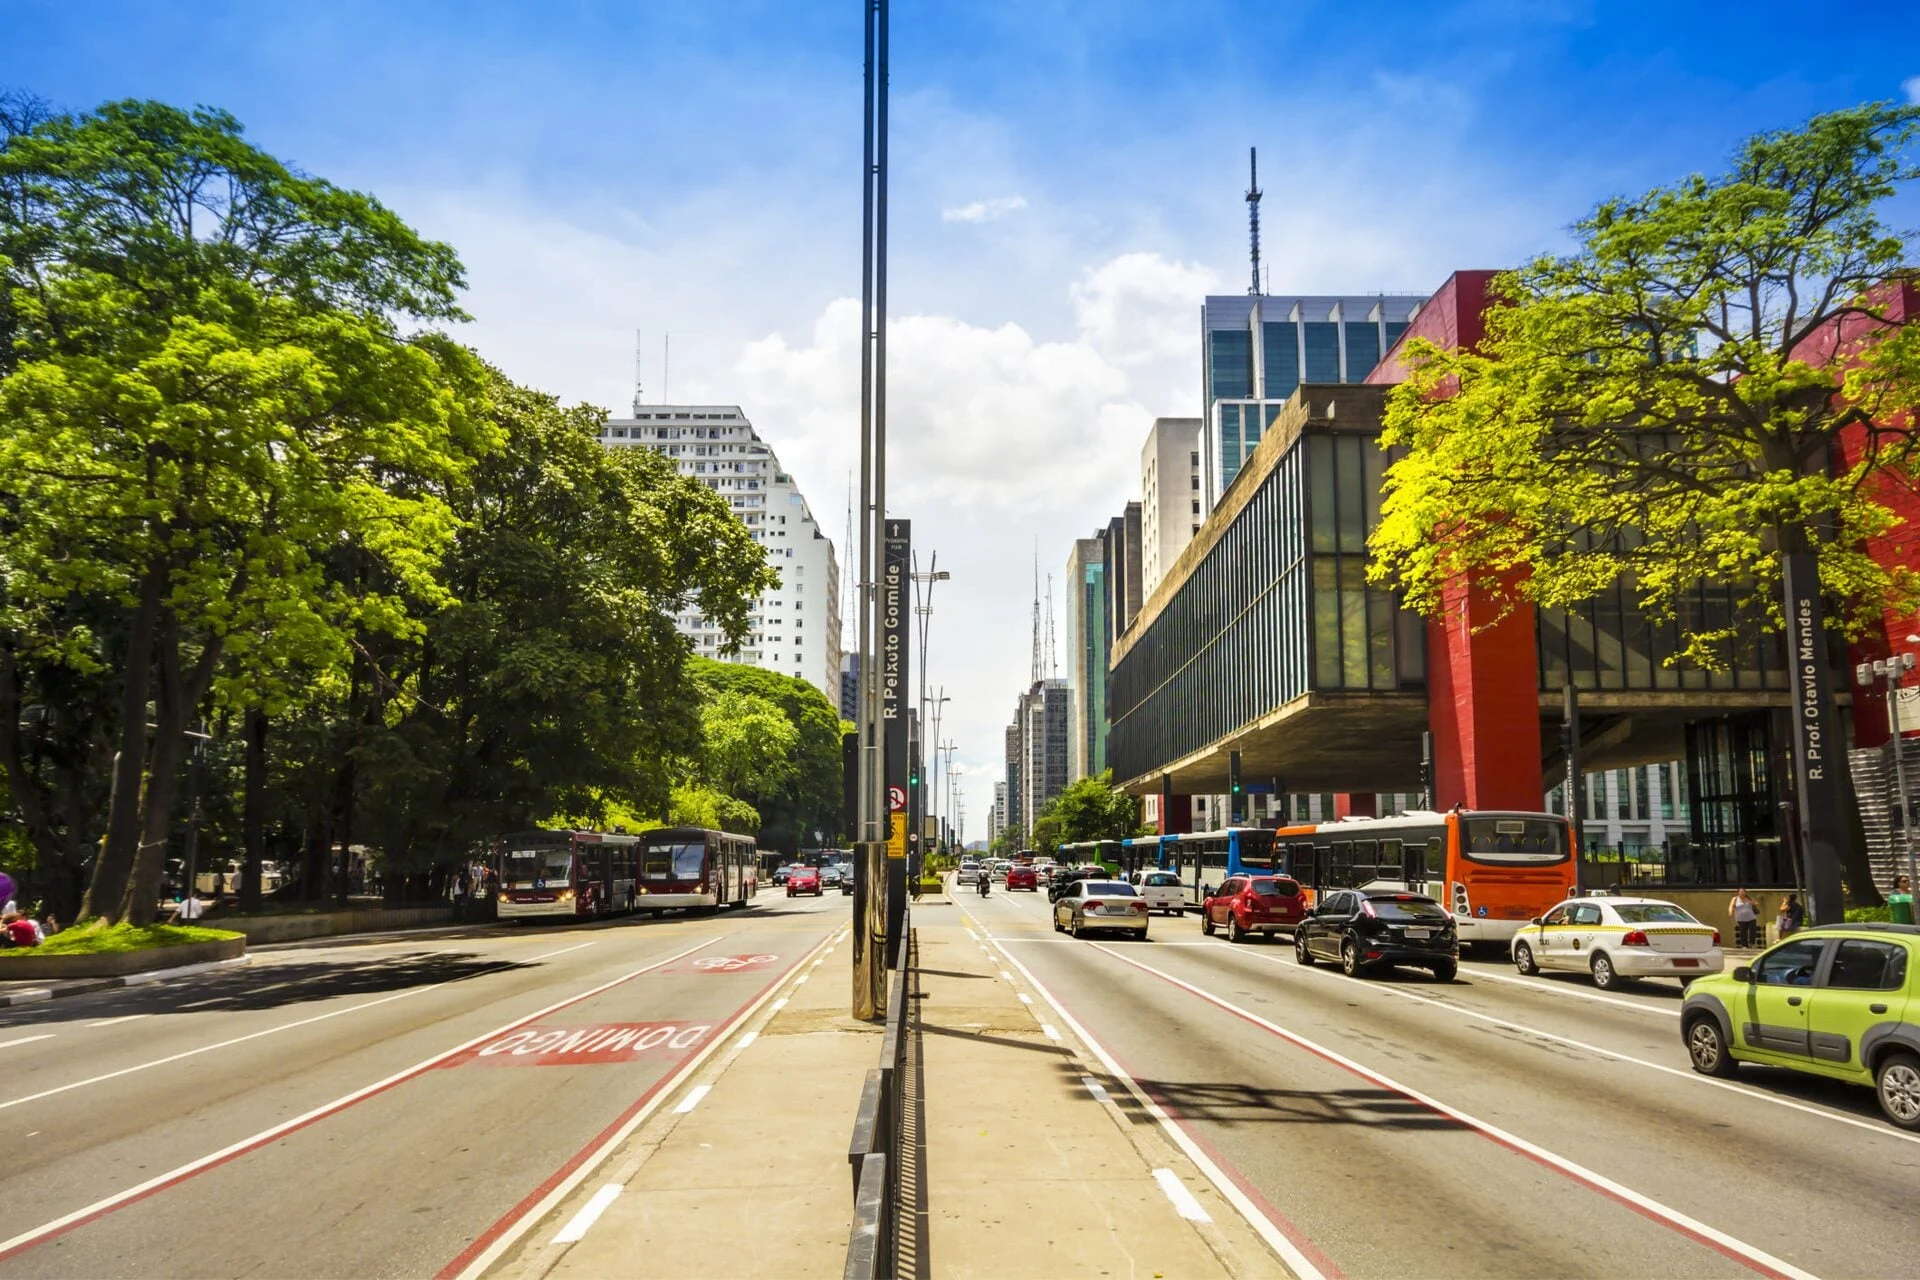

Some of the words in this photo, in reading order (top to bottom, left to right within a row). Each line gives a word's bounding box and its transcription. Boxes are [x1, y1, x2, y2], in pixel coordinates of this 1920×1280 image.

[884, 564, 899, 628] Gomide
[1798, 598, 1813, 660] Mendes
[883, 703, 897, 719] R.
[1806, 721, 1822, 760] Prof.
[1809, 764, 1823, 780] R.
[478, 1024, 712, 1057] DOMINGO
